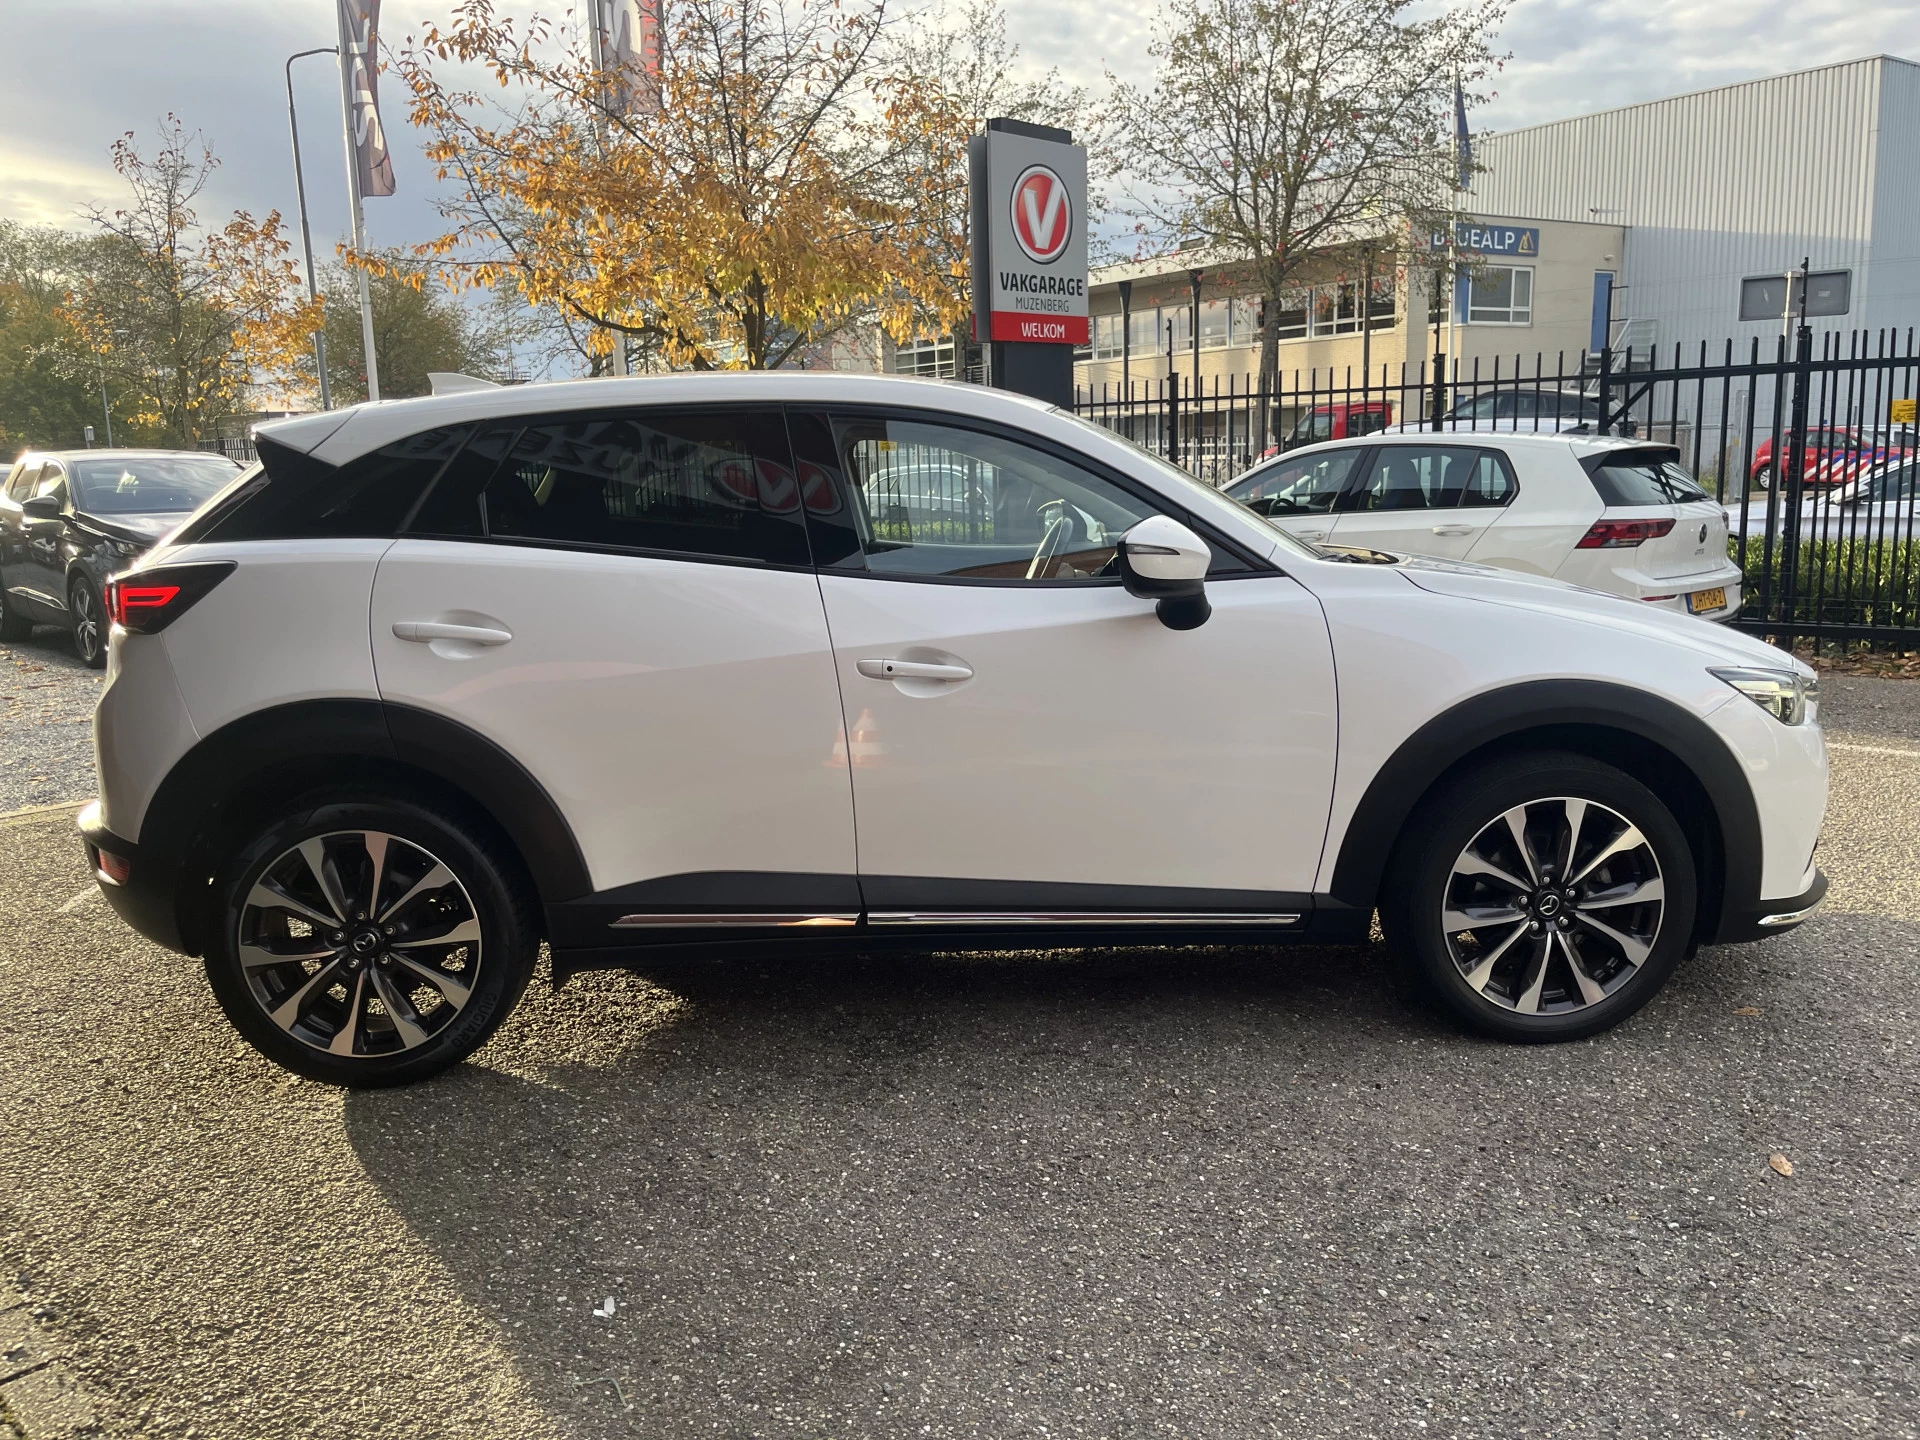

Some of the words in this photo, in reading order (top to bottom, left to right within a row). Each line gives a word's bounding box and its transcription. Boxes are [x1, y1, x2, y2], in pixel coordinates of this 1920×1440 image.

[1434, 228, 1516, 249] BUEALP
[1000, 271, 1083, 297] VAKGARAGE
[1015, 296, 1069, 313] MUZENBERG
[1021, 321, 1066, 339] WELKOM
[451, 992, 498, 1048] GIUGIARO
